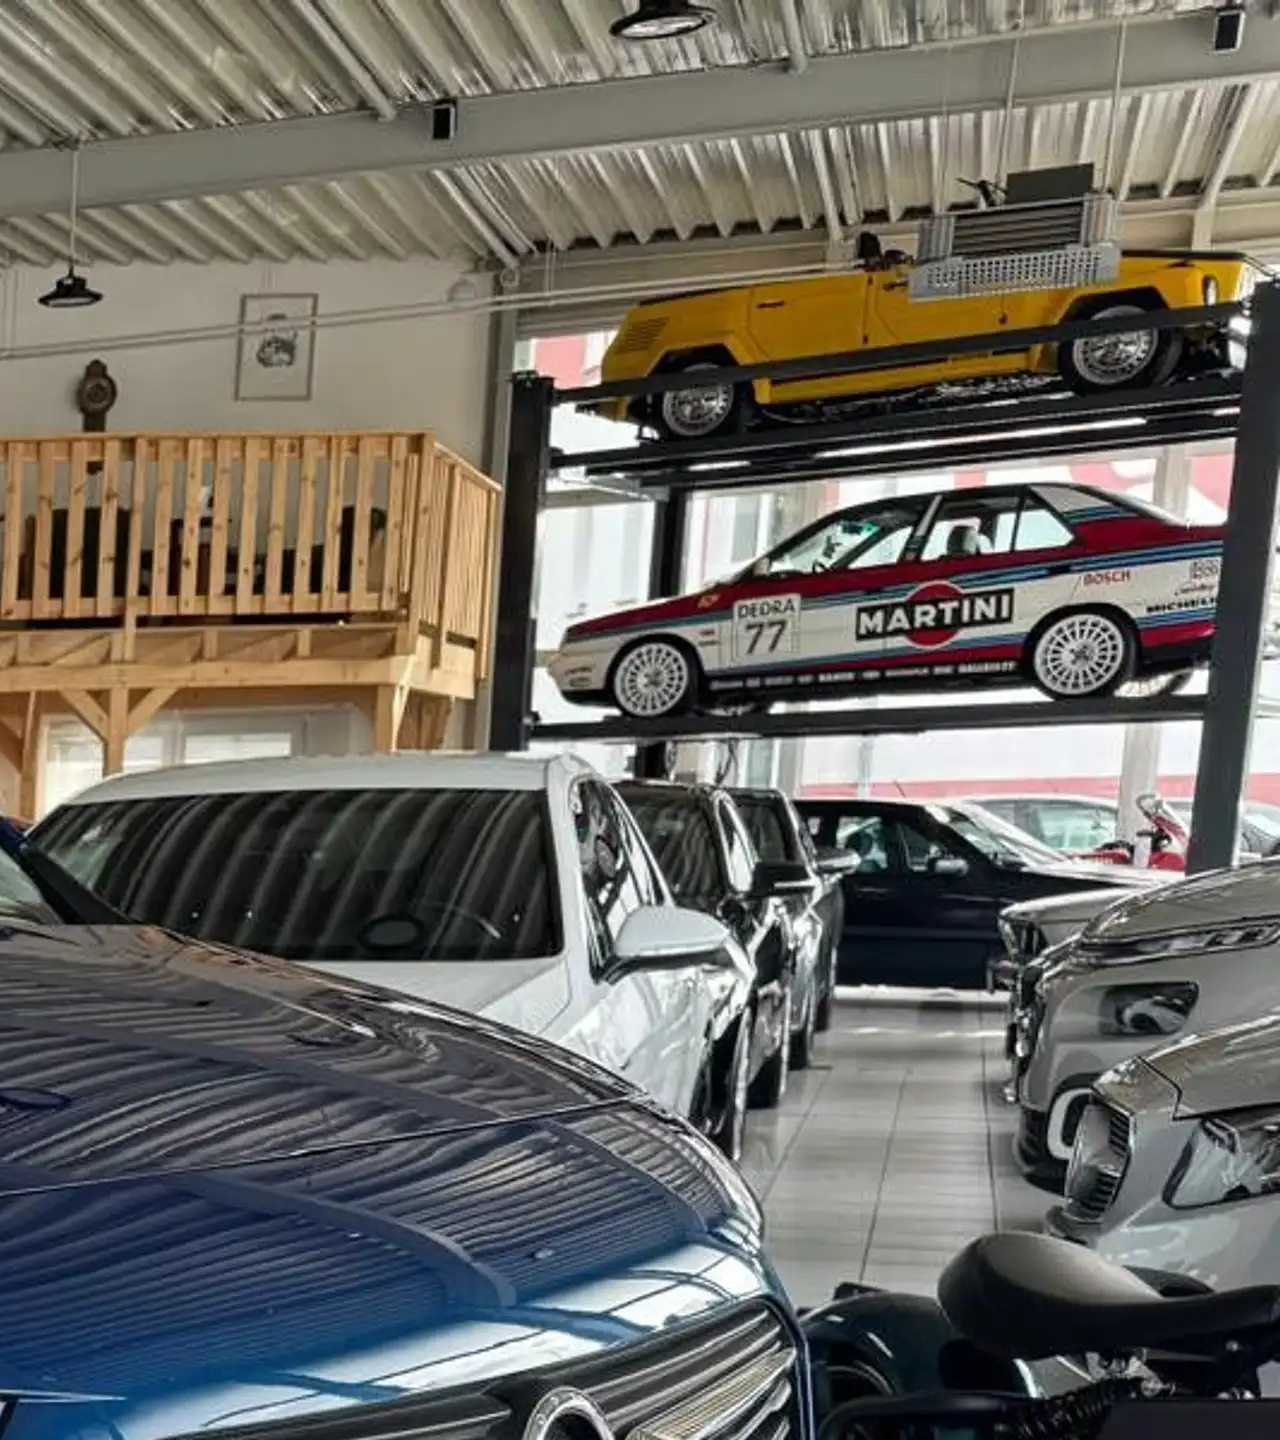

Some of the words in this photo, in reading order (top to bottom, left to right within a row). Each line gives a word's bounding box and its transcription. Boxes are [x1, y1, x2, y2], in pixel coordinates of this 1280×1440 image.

[1083, 570, 1131, 587] BOSCH
[738, 597, 797, 619] DEDRA
[858, 592, 1011, 636] MARTINI
[744, 619, 789, 655] 77
